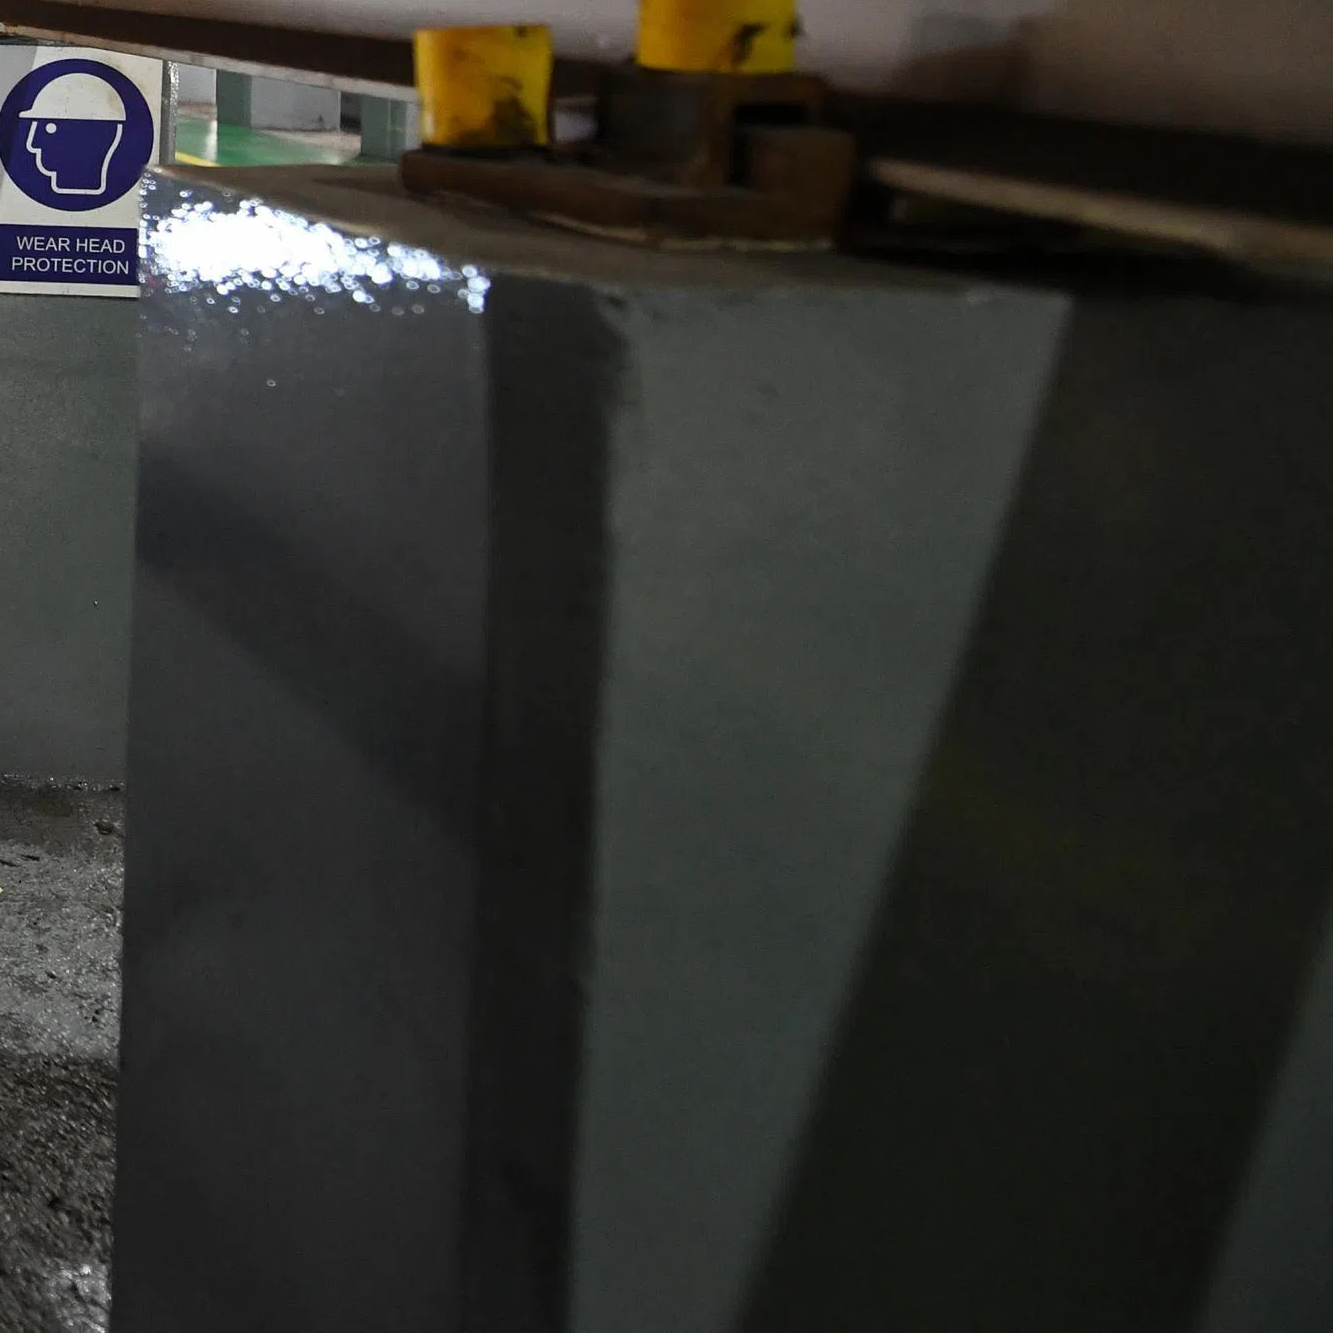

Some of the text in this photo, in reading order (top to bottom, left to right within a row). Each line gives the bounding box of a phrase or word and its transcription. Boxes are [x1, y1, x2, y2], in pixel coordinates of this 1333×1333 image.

[16, 235, 125, 254] WEAR HEAD
[11, 256, 129, 275] PROTECTION
